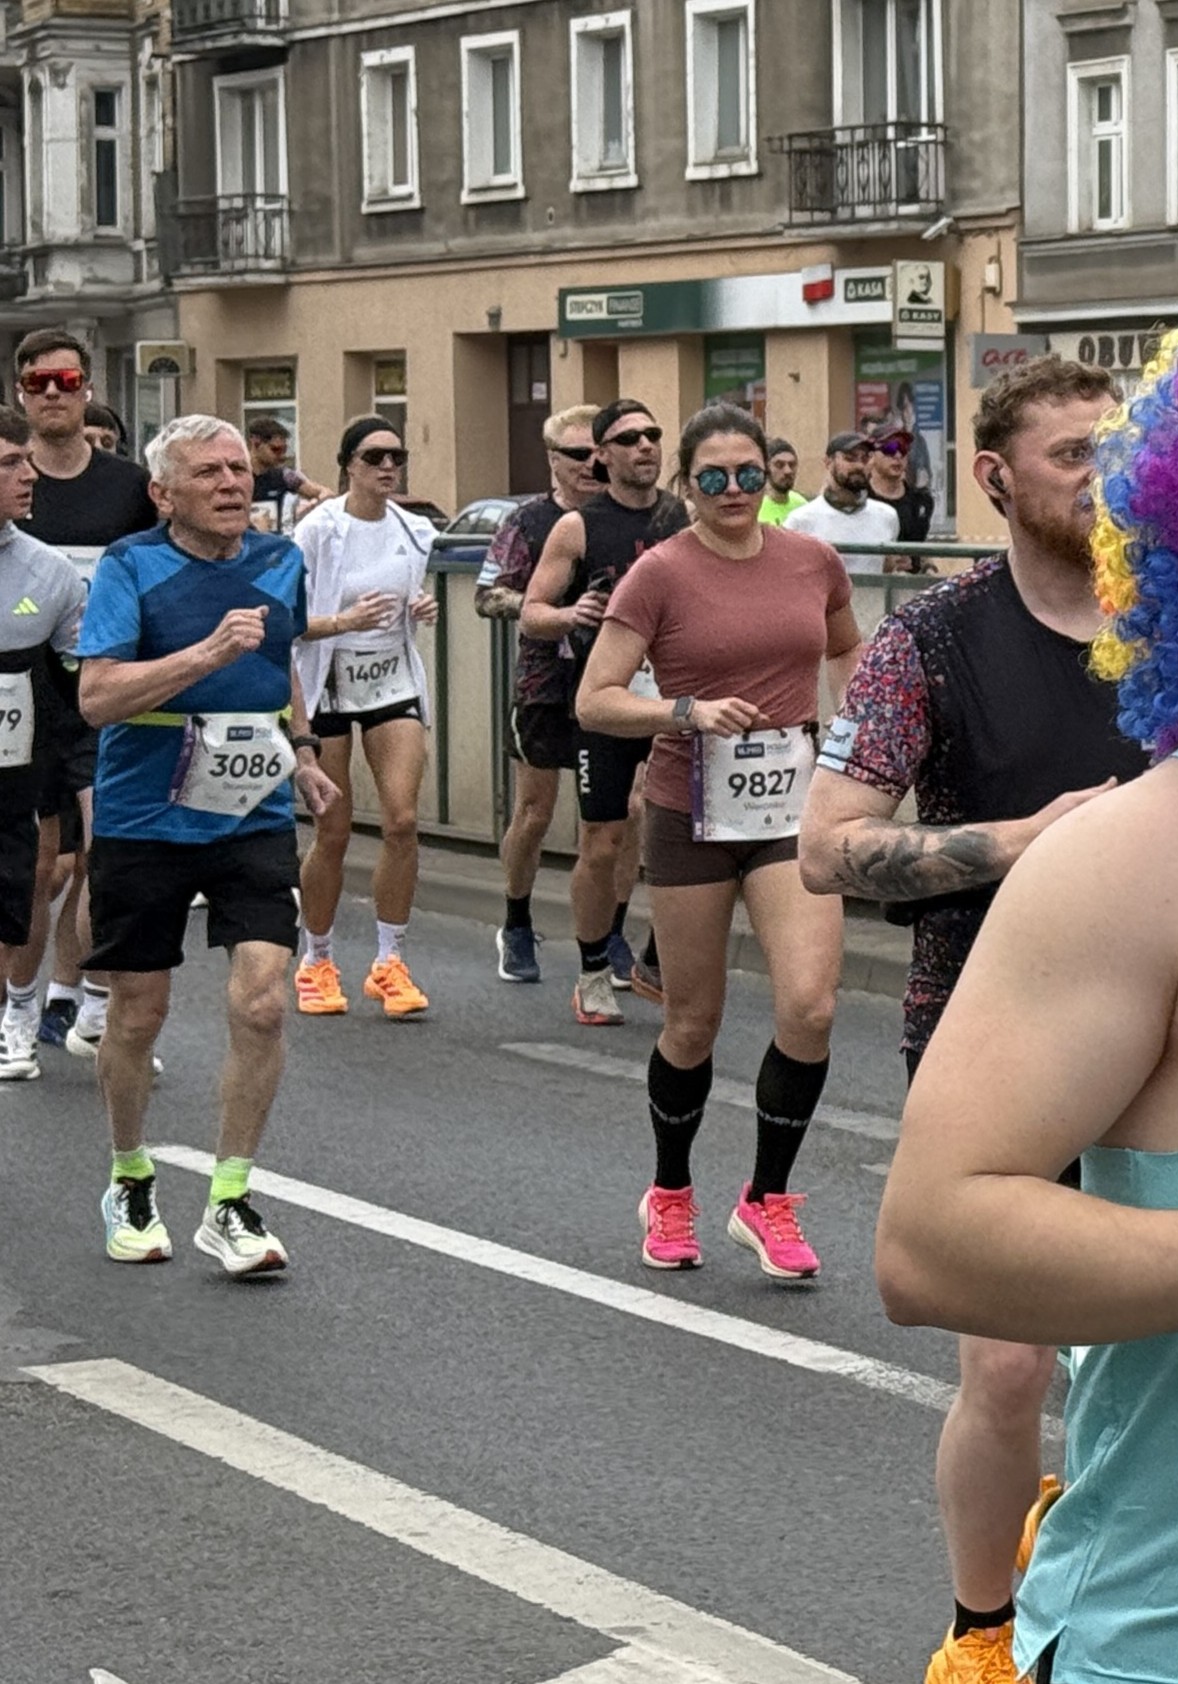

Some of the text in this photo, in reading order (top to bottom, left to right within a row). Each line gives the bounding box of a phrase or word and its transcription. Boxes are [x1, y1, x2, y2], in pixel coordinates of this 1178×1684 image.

[345, 655, 400, 684] 14097
[208, 752, 282, 779] 3086
[727, 767, 797, 798] 9827
